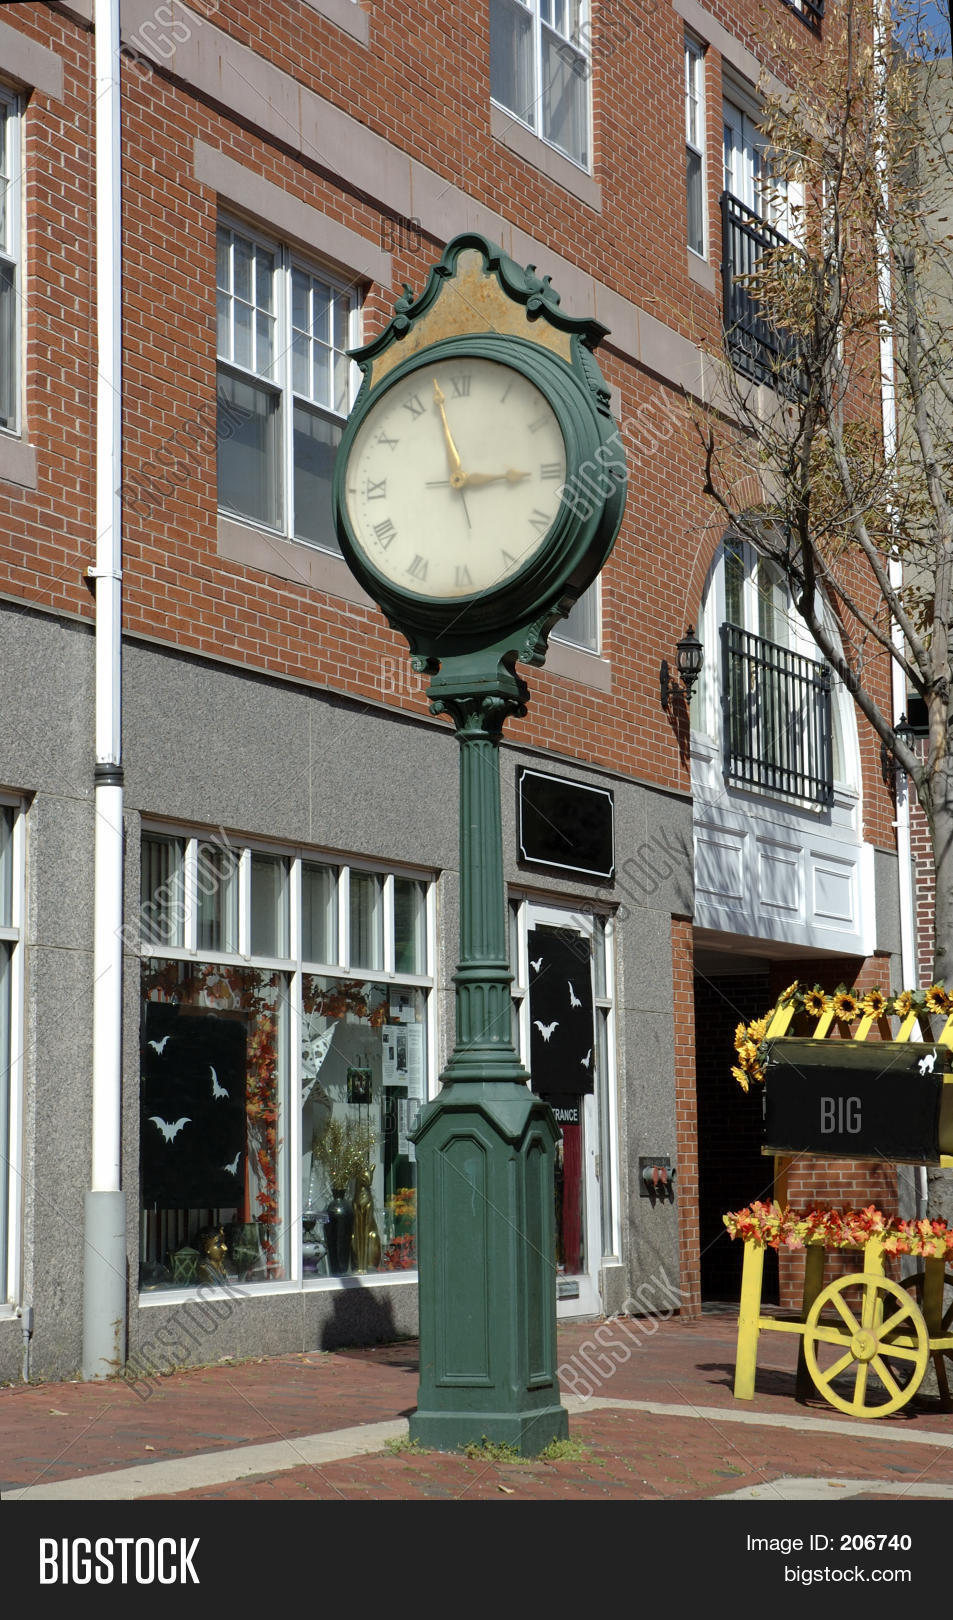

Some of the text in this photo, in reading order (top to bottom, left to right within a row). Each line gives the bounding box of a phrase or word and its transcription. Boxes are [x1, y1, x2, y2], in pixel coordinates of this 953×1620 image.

[450, 375, 471, 399] XII
[402, 393, 426, 421] XI
[367, 478, 387, 501] IX
